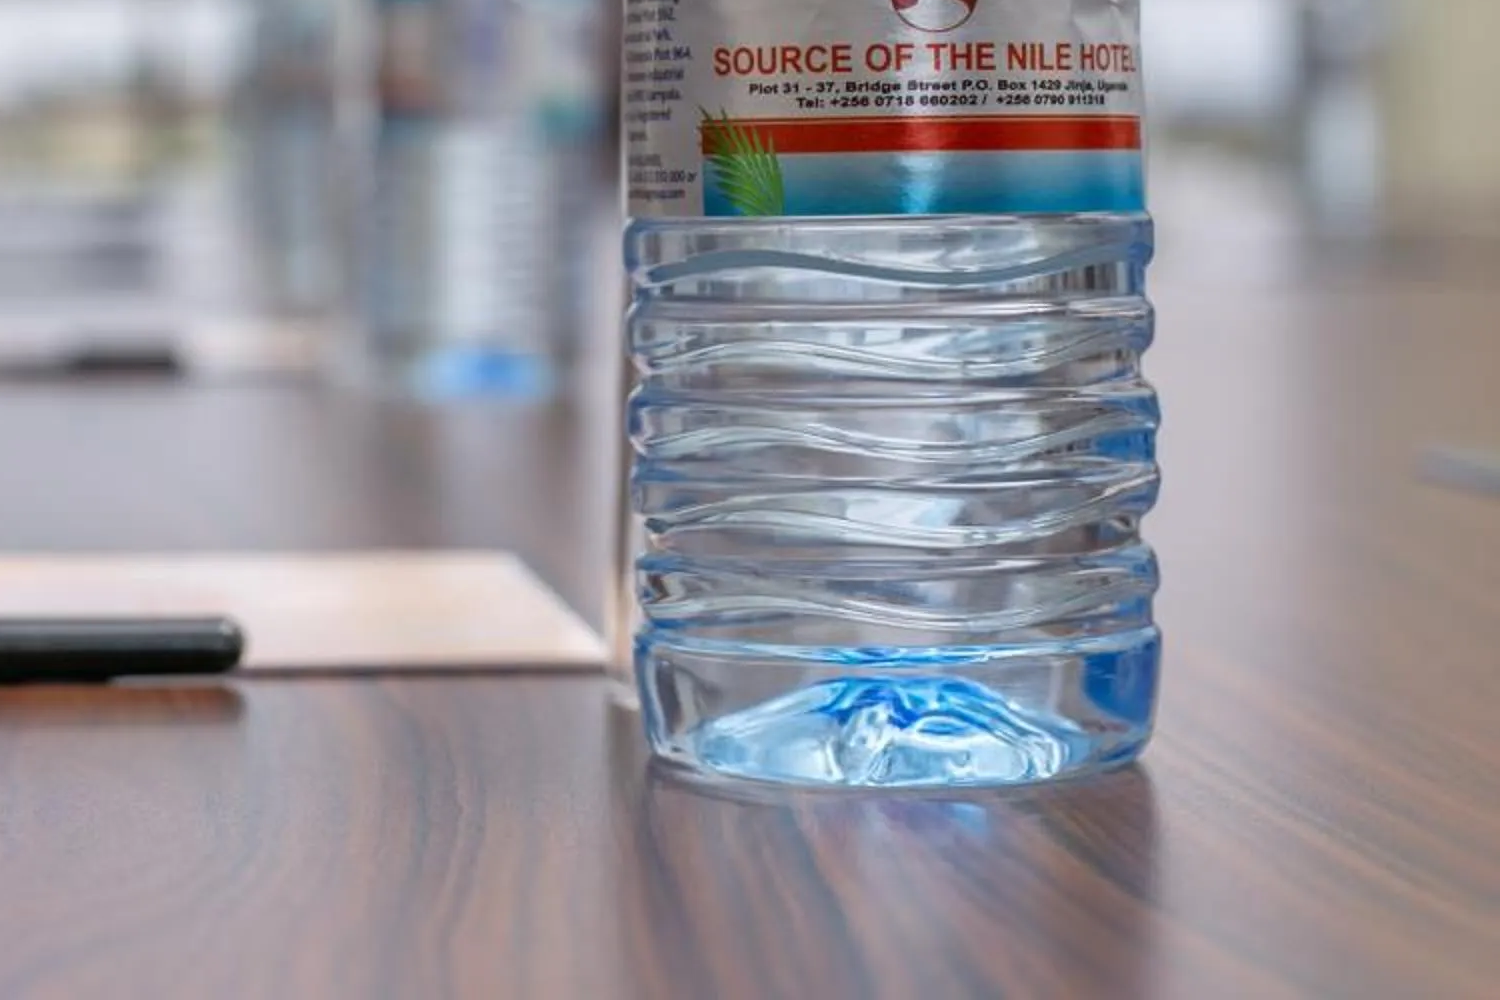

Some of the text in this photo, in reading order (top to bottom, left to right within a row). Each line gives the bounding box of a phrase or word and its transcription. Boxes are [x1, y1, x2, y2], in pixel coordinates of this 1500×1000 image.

[713, 44, 853, 76] SOURCE
[865, 42, 915, 73] OF
[925, 42, 996, 71] THE
[1007, 42, 1073, 71] NILE
[1079, 42, 1136, 73] HOTEL
[749, 83, 779, 95] Plot
[783, 81, 799, 93] 31
[845, 80, 901, 95] Bridge
[907, 79, 956, 92] Street
[997, 79, 1026, 91] Box
[797, 96, 825, 108] Tel:
